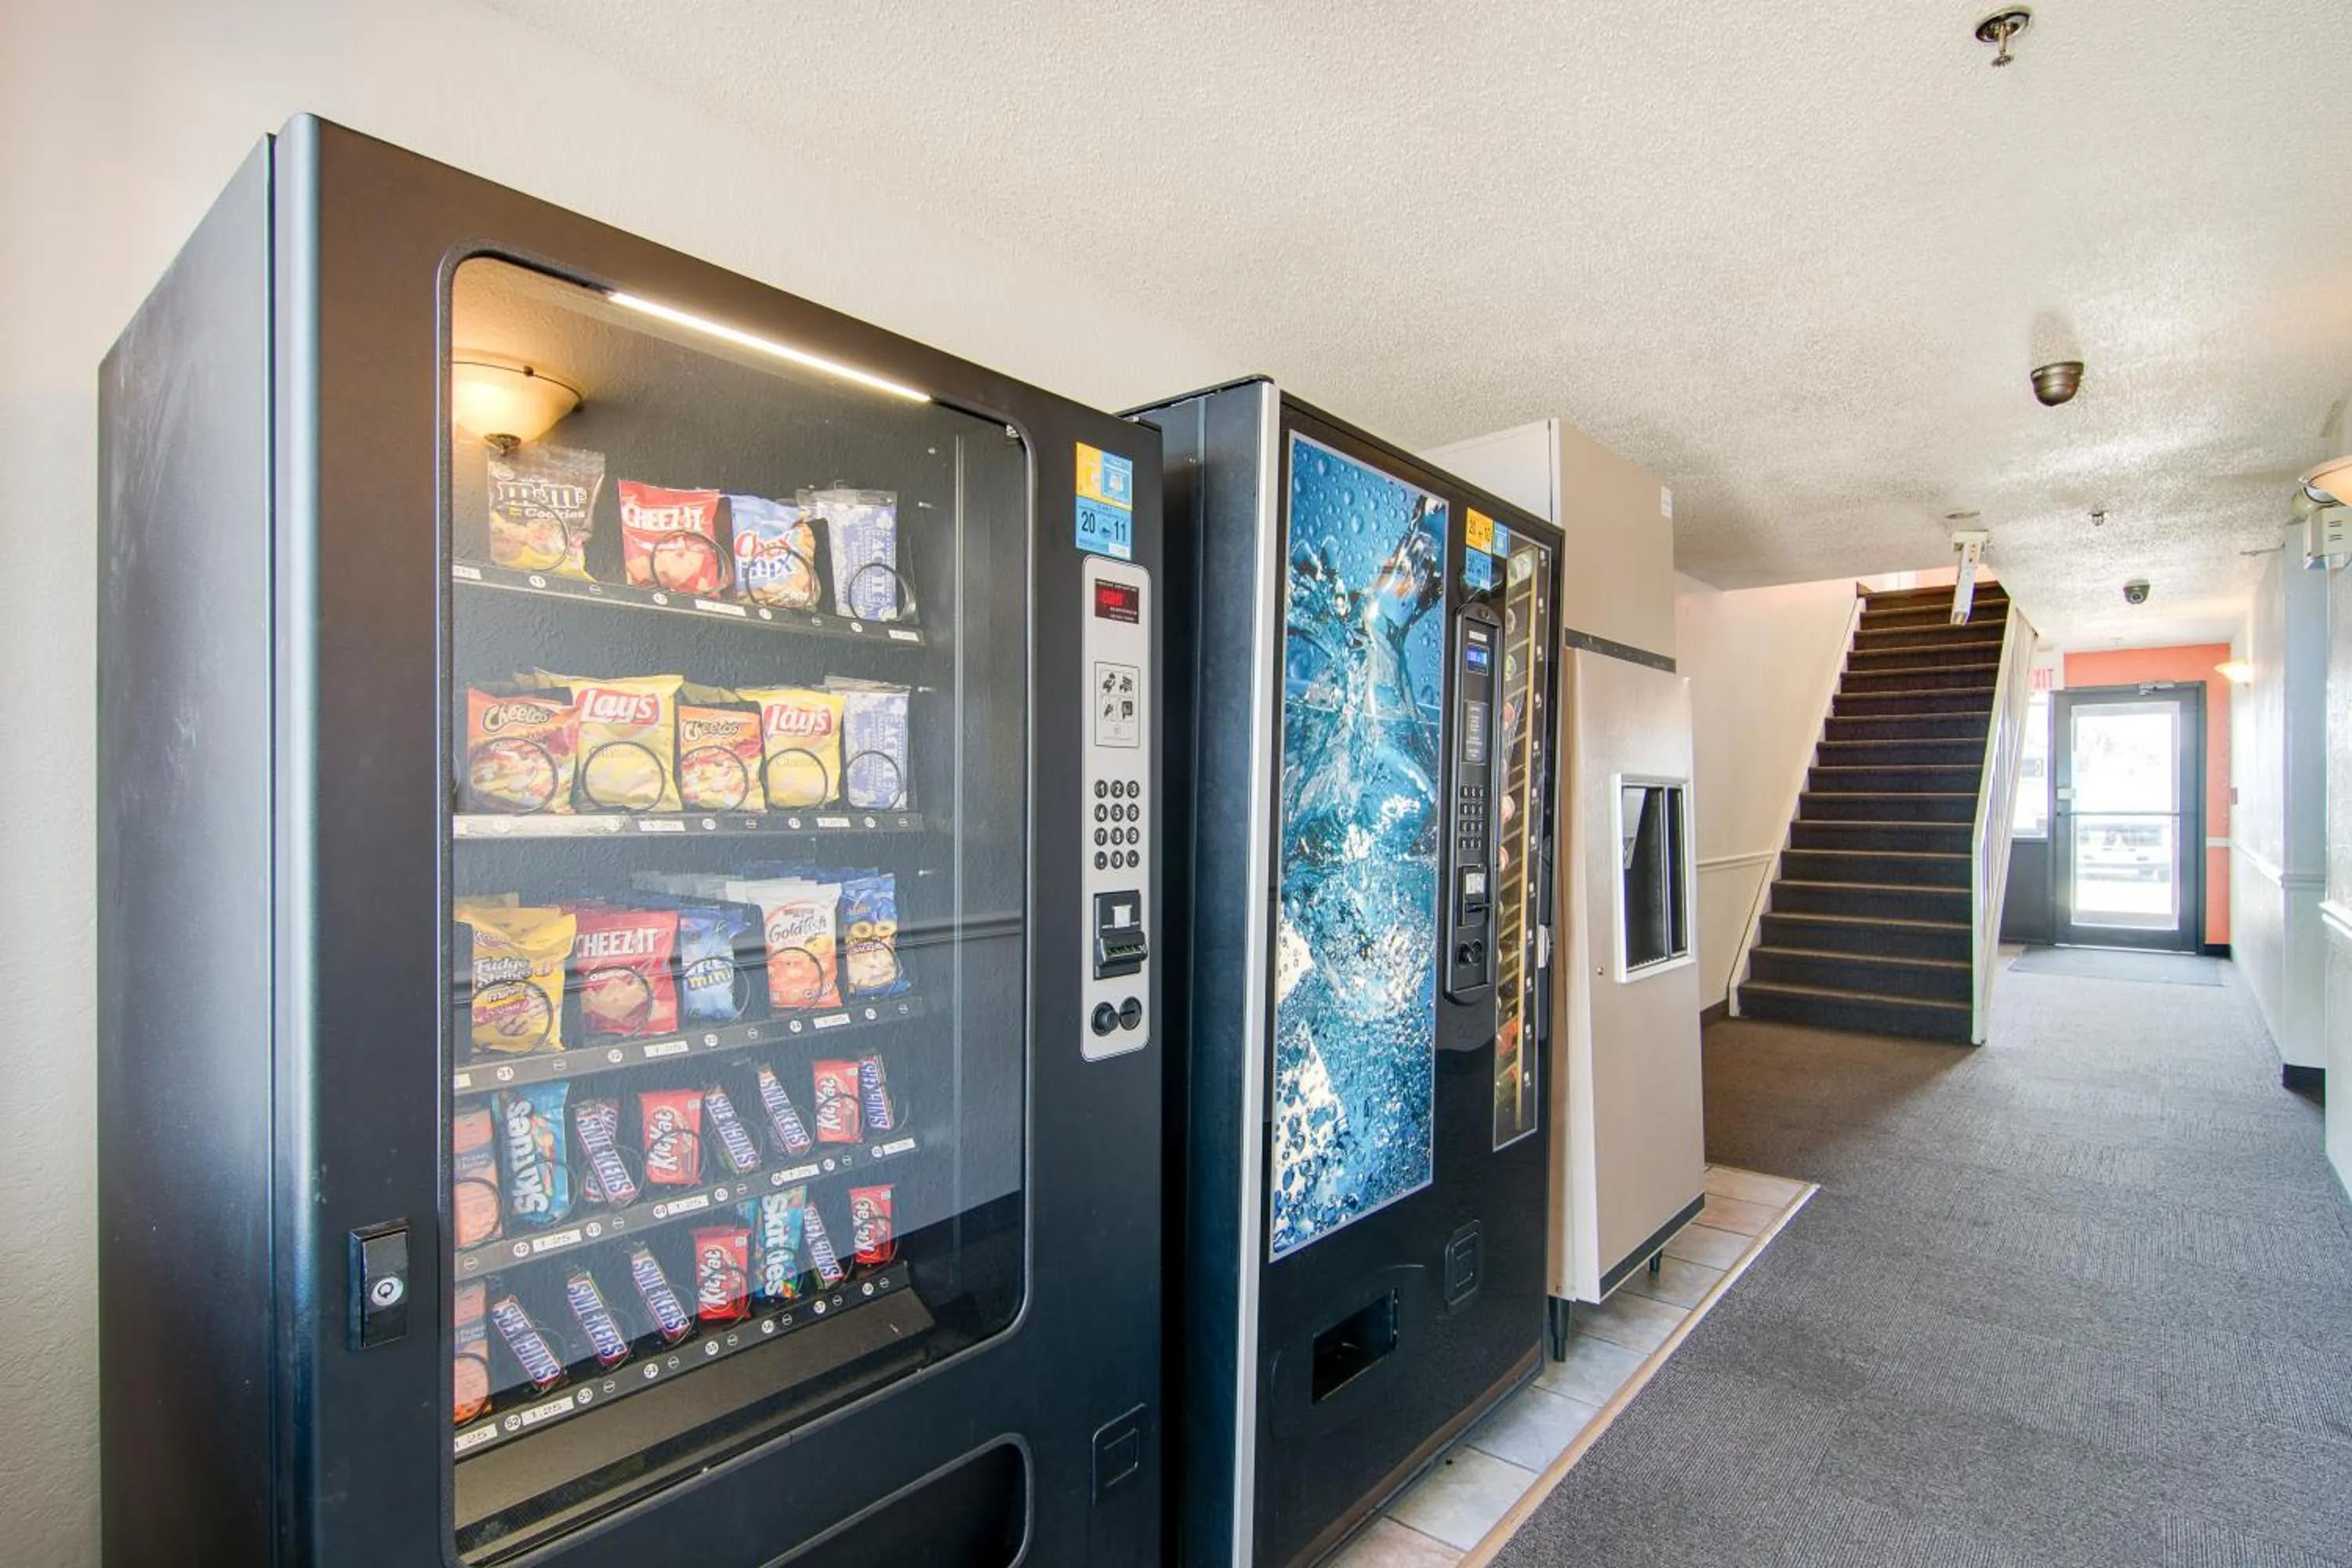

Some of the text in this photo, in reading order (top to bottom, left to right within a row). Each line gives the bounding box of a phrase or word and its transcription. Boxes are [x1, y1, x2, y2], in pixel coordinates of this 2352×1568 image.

[1082, 511, 1095, 534] 20
[1114, 520, 1126, 542] 11
[2031, 668, 2055, 688] XIT
[484, 703, 555, 733] Cheetos
[682, 719, 742, 741] Cheetos
[769, 915, 827, 942] Goldfish
